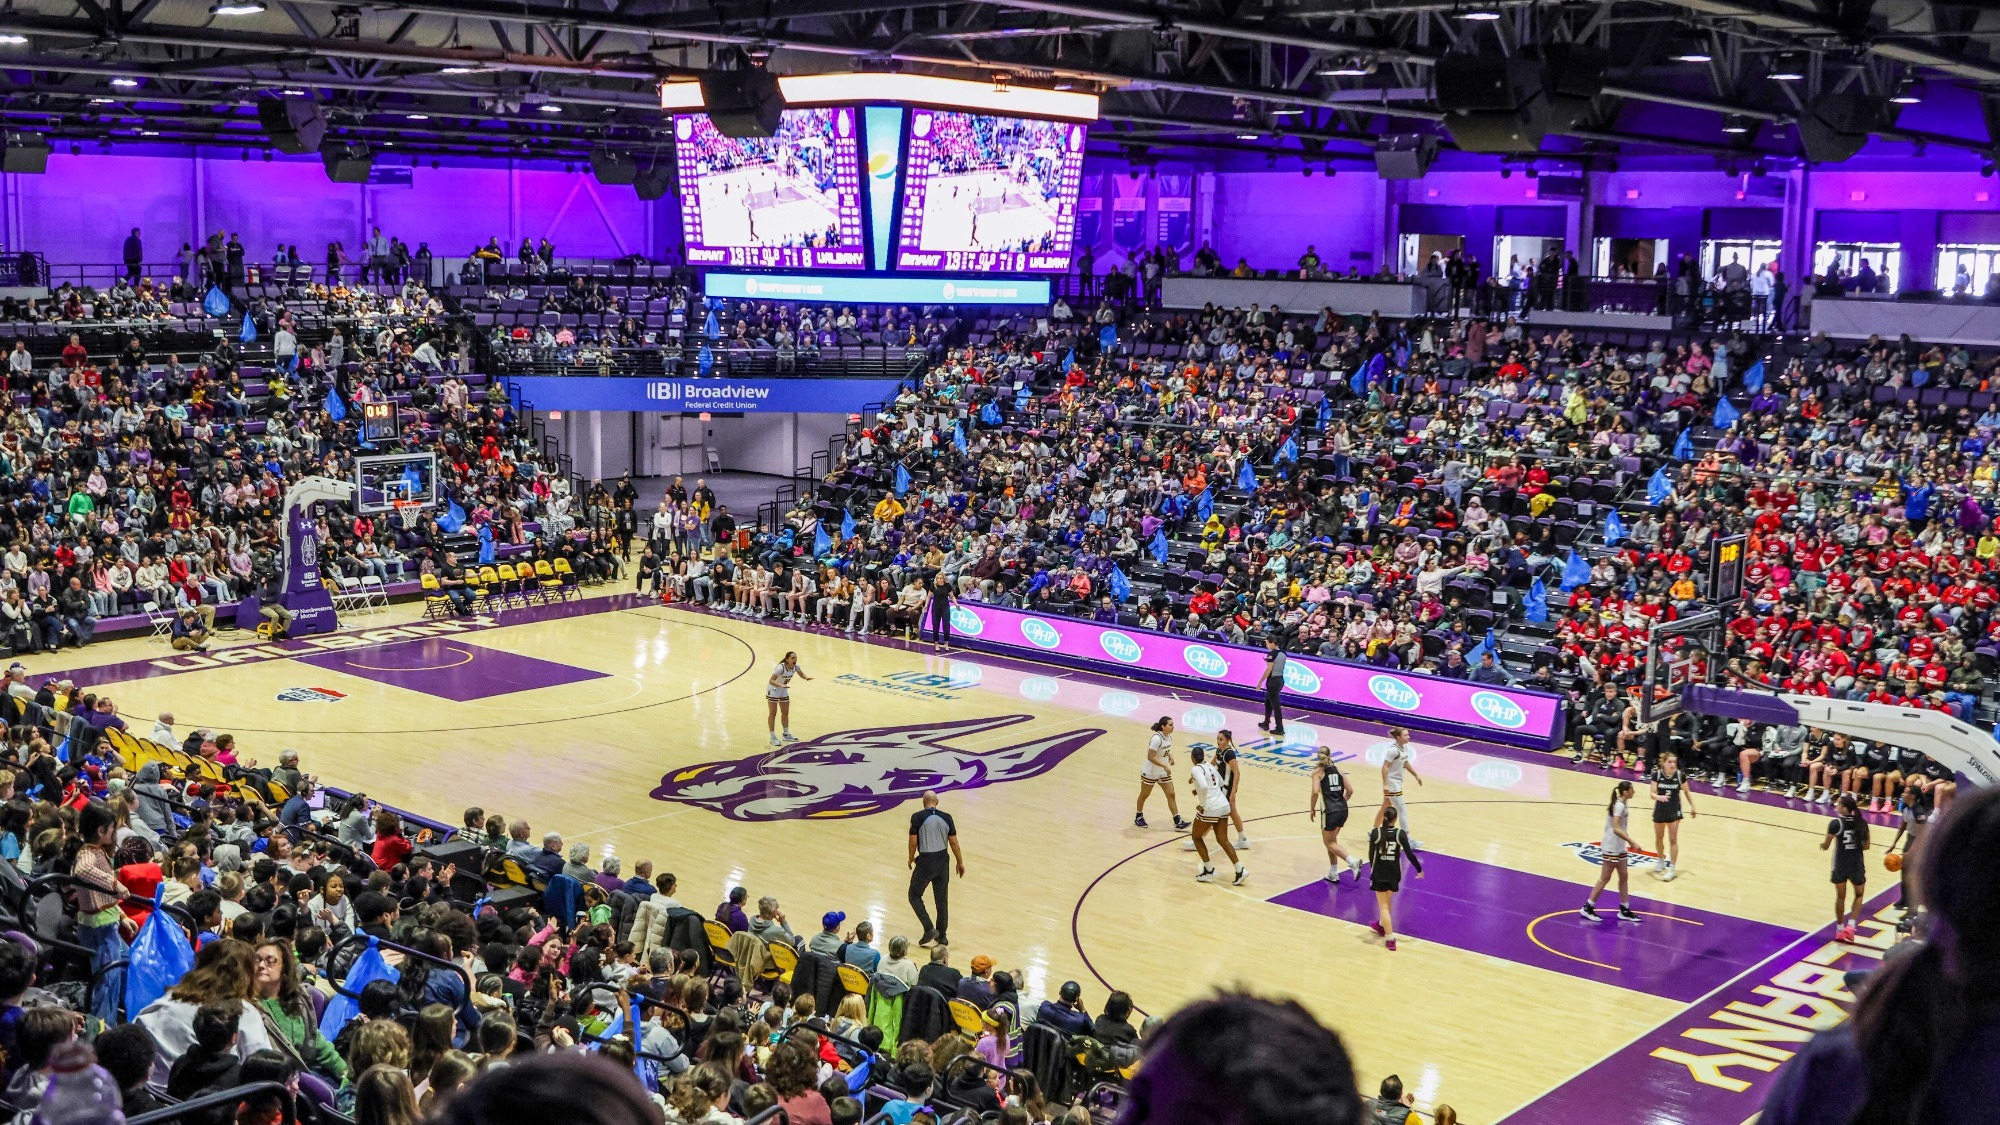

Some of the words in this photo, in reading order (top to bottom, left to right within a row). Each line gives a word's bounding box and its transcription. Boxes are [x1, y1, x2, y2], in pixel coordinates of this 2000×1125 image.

[730, 247, 744, 265] 13
[802, 249, 812, 268] 8
[945, 252, 962, 270] 13
[1016, 254, 1026, 271] 8
[685, 385, 769, 398] Broadview
[300, 606, 332, 614] Northwestern
[1026, 622, 1054, 643] CDPHP
[149, 615, 502, 672] UALBANY
[1105, 635, 1134, 656] CDPHP
[1189, 650, 1222, 672] CDPHP
[836, 674, 962, 700] Broadview
[1374, 680, 1413, 704] CDPHP
[1478, 698, 1518, 721] CDPHP
[1328, 774, 1339, 786] 10
